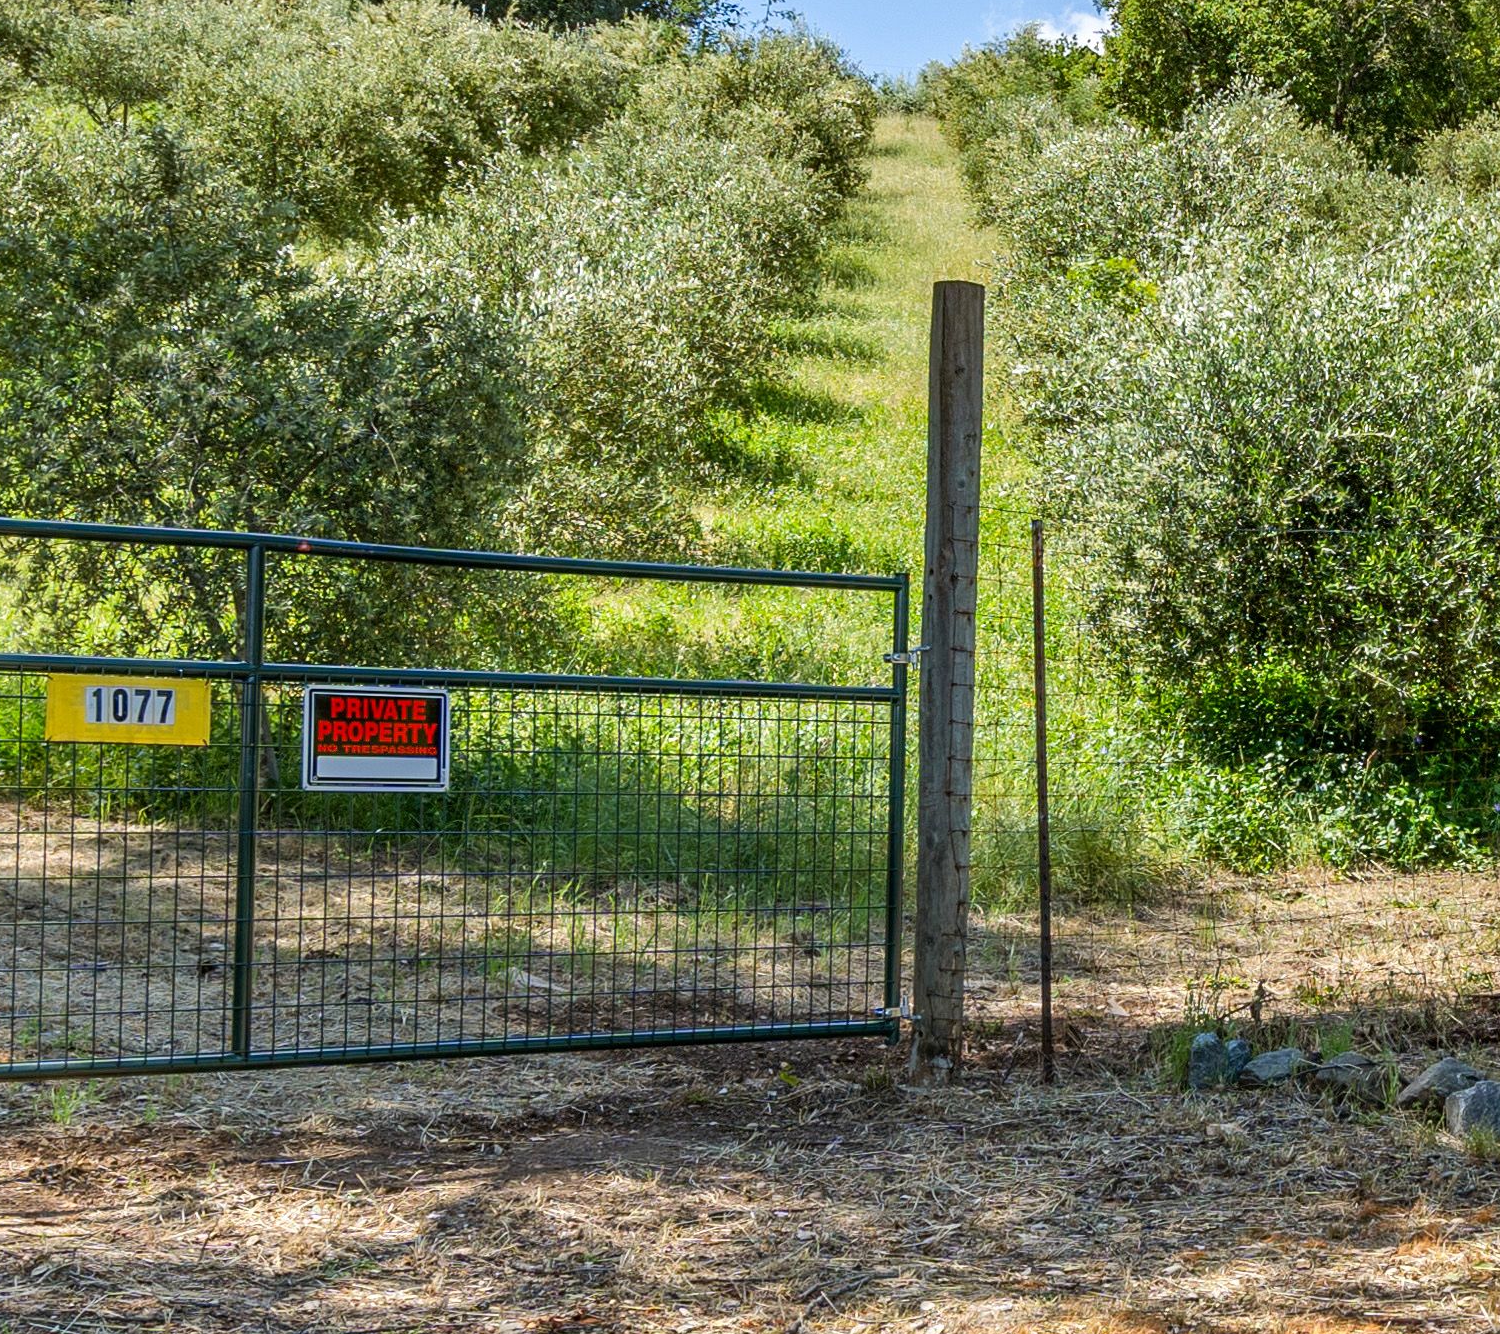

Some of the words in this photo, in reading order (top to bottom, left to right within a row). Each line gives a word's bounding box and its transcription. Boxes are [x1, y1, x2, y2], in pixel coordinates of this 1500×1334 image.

[91, 687, 174, 723] 1077
[330, 696, 427, 721] PRIVATE
[317, 720, 438, 744] PROPERTY
[317, 743, 338, 753] NO
[343, 744, 438, 756] TRESPASSING
